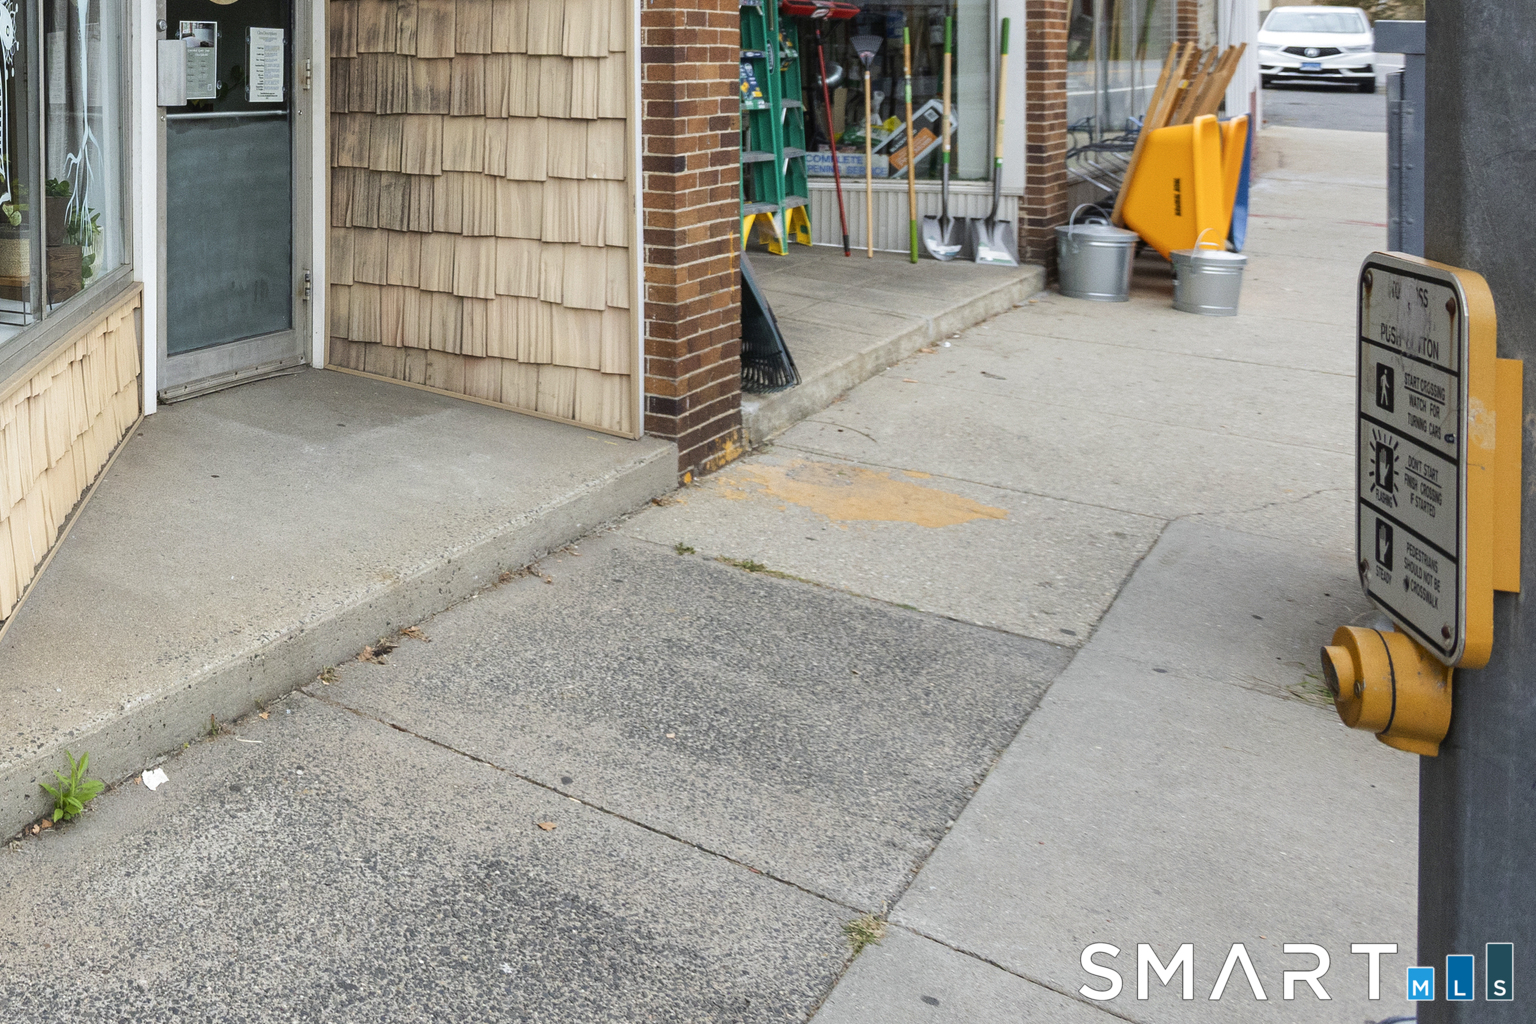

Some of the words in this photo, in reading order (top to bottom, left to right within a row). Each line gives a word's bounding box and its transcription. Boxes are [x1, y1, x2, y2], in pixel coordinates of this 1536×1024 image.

[806, 153, 863, 165] COMLETE
[846, 166, 888, 176] SERICE
[1404, 372, 1420, 389] START
[1430, 402, 1440, 420] FOR
